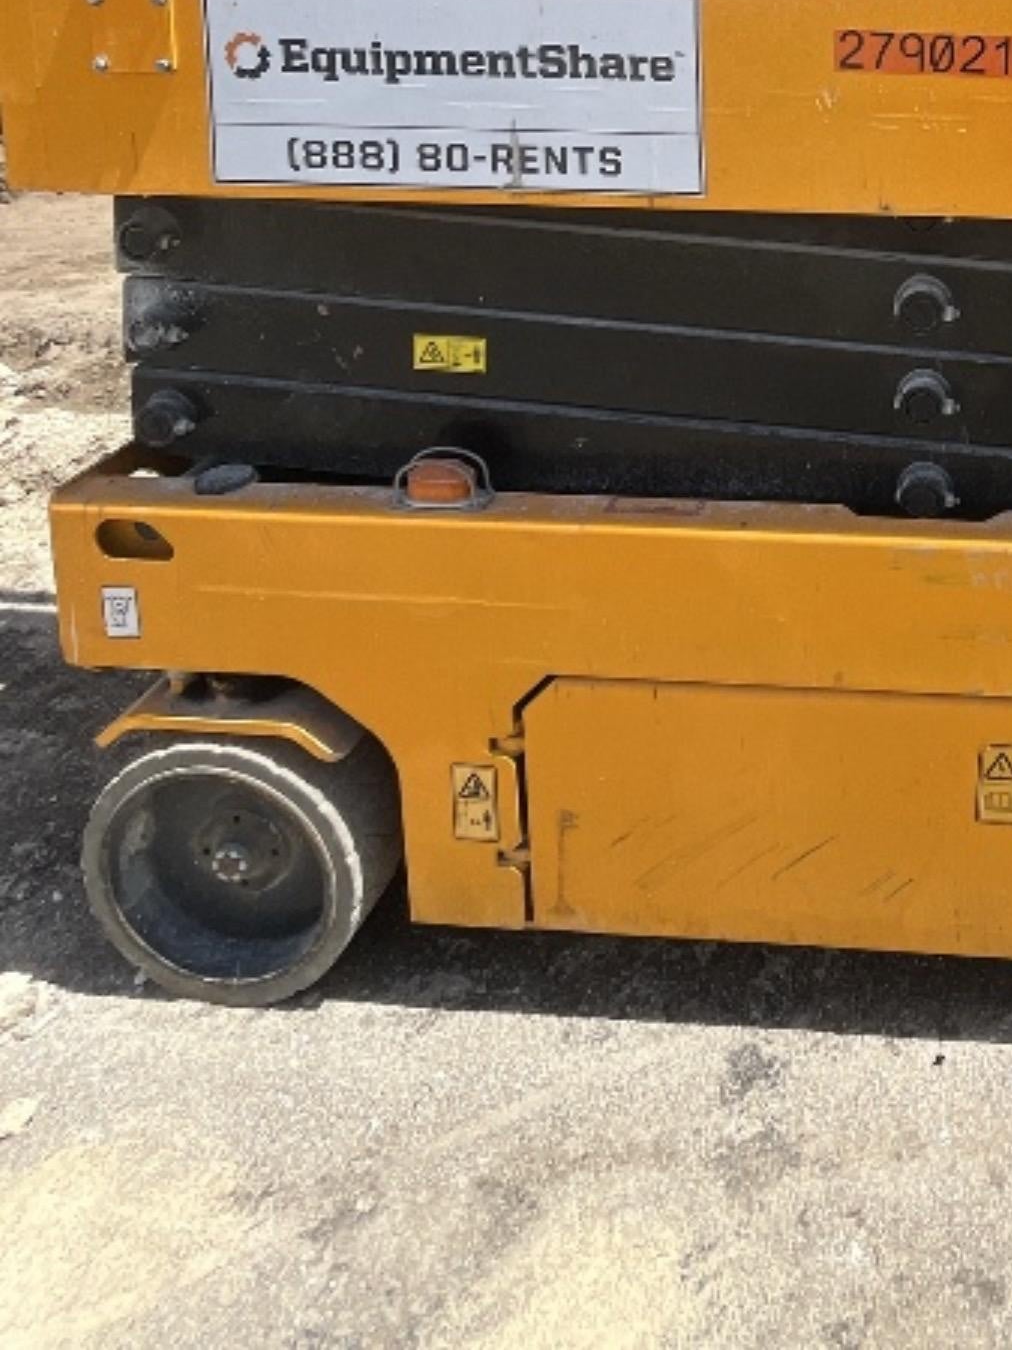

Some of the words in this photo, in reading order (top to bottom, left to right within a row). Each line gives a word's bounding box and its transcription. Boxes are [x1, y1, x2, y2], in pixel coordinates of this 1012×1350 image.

[277, 37, 676, 84] EquipmentShare
[838, 29, 1012, 76] 279021
[286, 136, 401, 173] (888)
[416, 143, 624, 177] 80-RENTS
